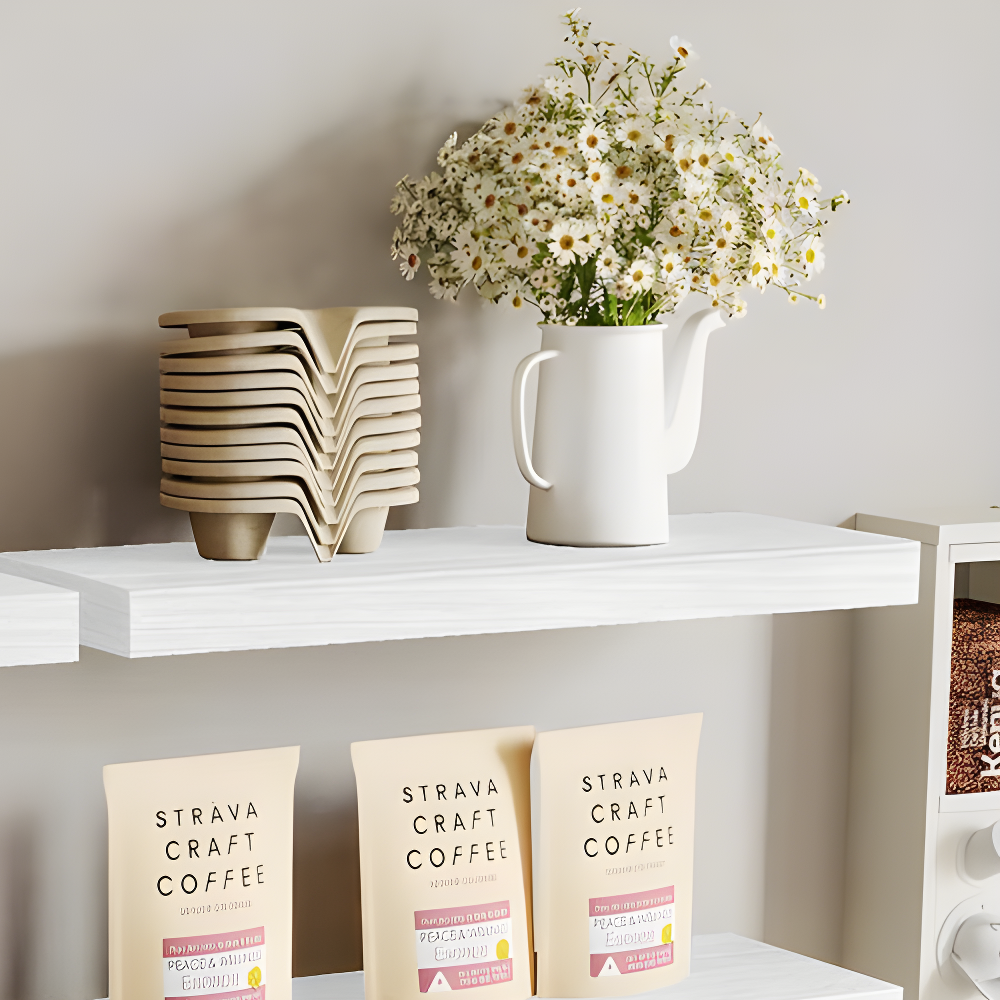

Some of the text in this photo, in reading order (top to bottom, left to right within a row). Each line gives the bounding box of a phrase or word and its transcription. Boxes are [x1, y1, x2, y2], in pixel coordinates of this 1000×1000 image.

[402, 778, 499, 804] STRAVA
[581, 766, 668, 793] STRAVA
[155, 801, 258, 829] STRAVA
[412, 808, 496, 835] CRAFT
[590, 794, 666, 824] CRAFT
[165, 832, 256, 861] CRAFT
[406, 839, 508, 870] COFFEE
[583, 826, 675, 858] COFFEE
[156, 864, 265, 897] COFFEE
